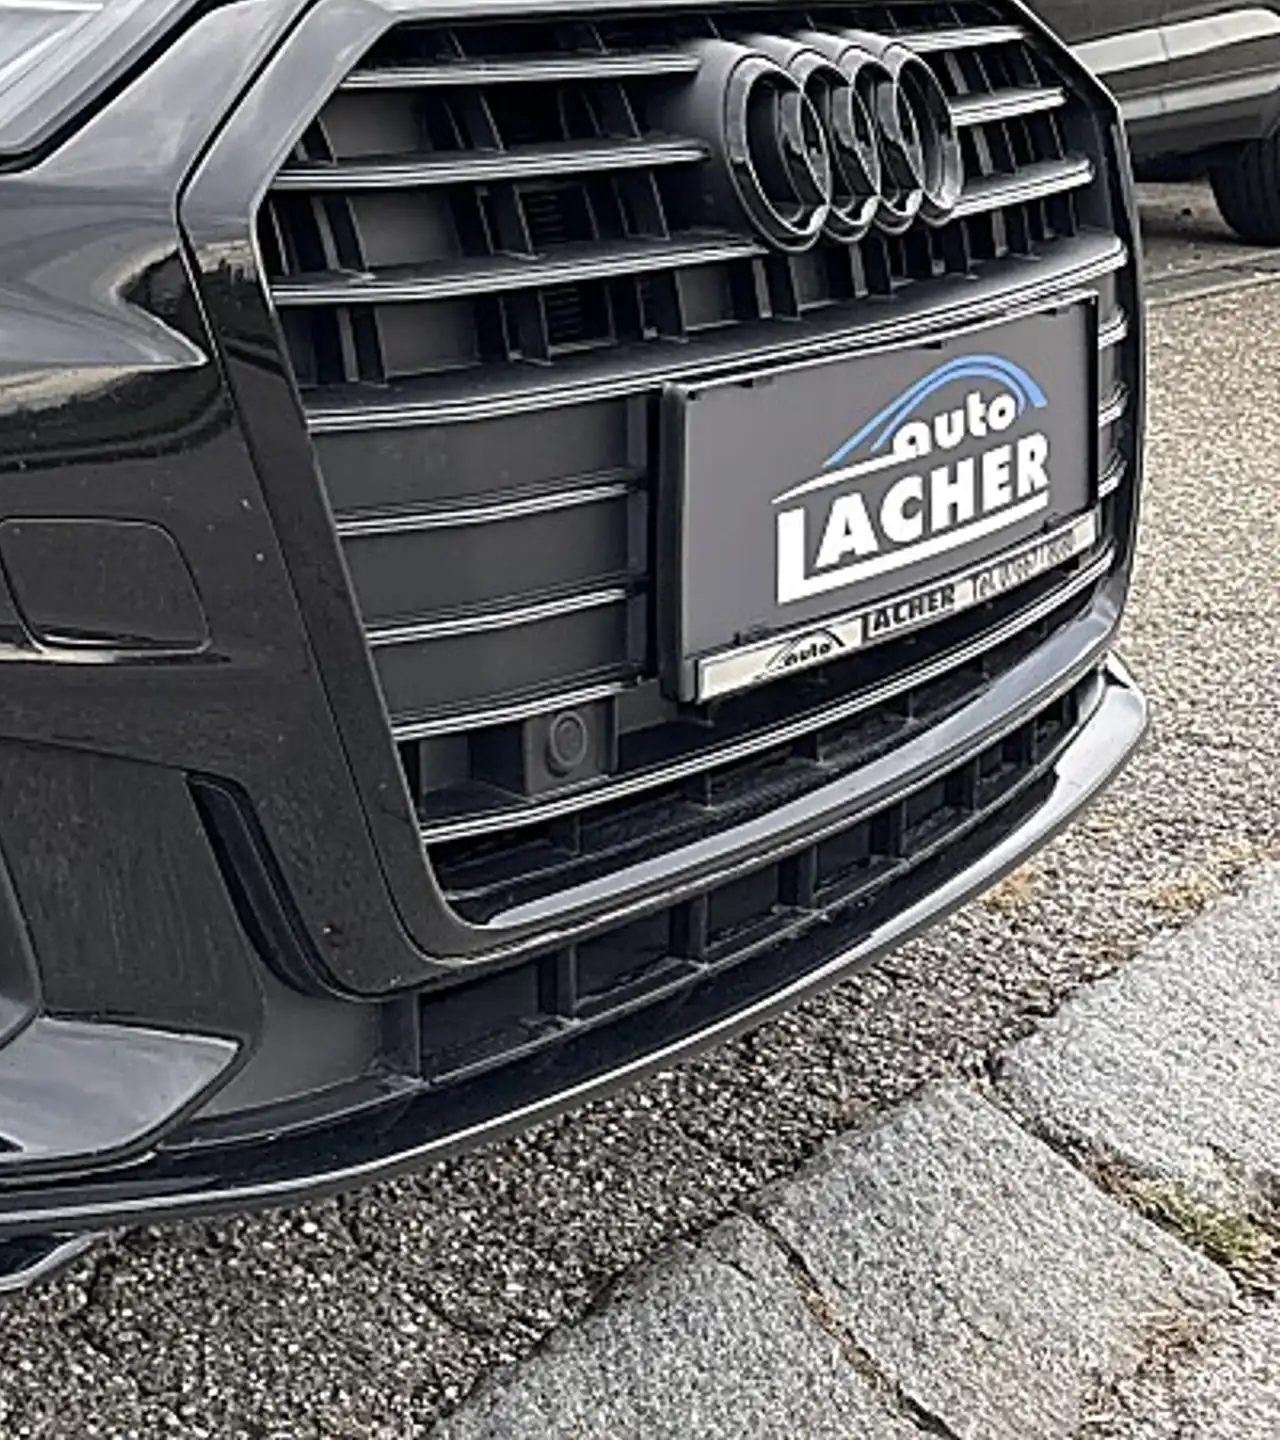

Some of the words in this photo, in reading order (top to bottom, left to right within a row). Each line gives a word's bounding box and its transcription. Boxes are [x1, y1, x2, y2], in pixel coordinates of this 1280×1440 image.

[892, 391, 1017, 458] auto
[776, 433, 1049, 606] LACHER
[860, 583, 955, 644] LACHER
